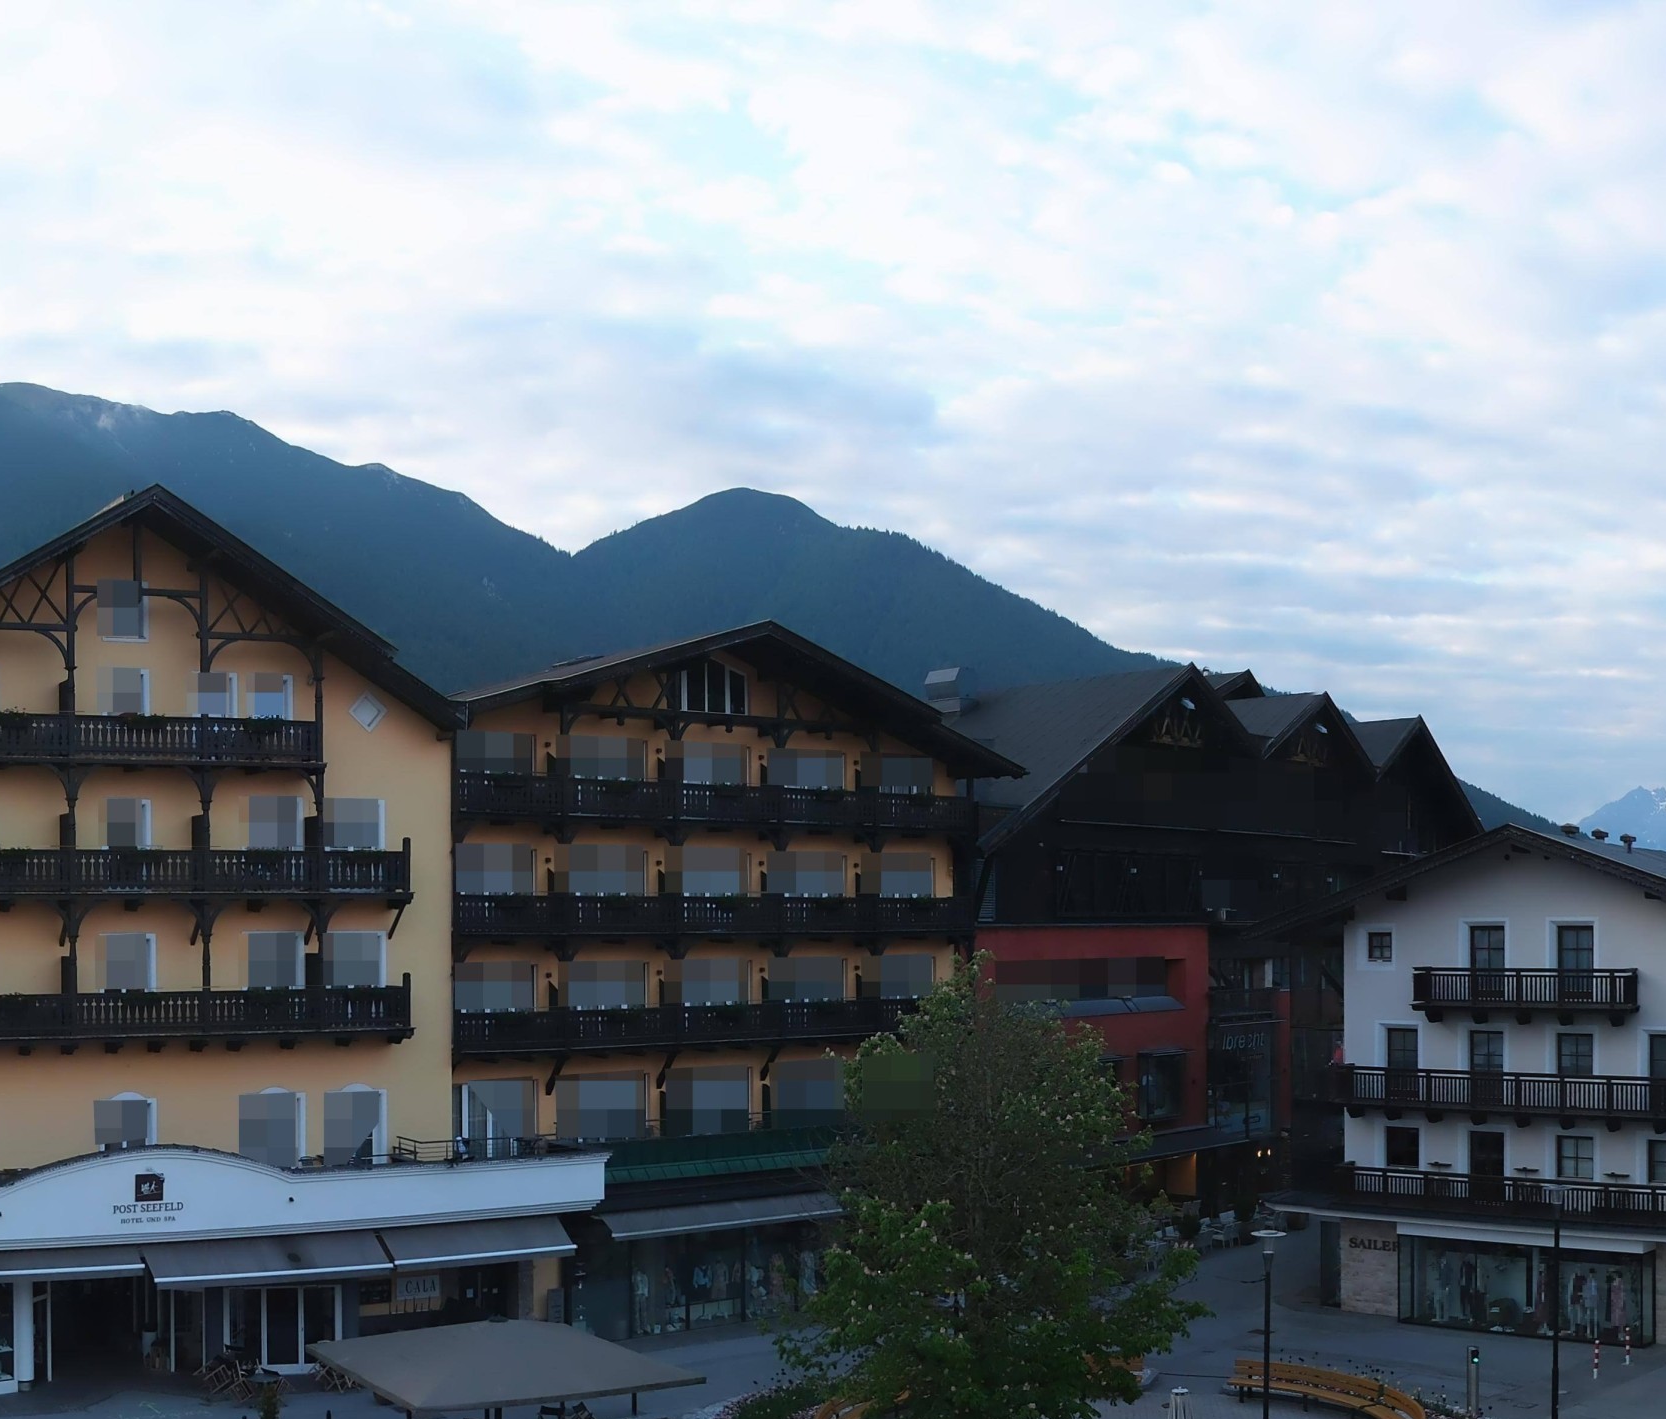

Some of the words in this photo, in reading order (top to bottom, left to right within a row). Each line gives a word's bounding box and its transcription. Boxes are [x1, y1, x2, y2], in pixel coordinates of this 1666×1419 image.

[113, 1204, 138, 1214] POST
[140, 1202, 184, 1212] SEEFELD
[405, 1279, 436, 1293] CALA
